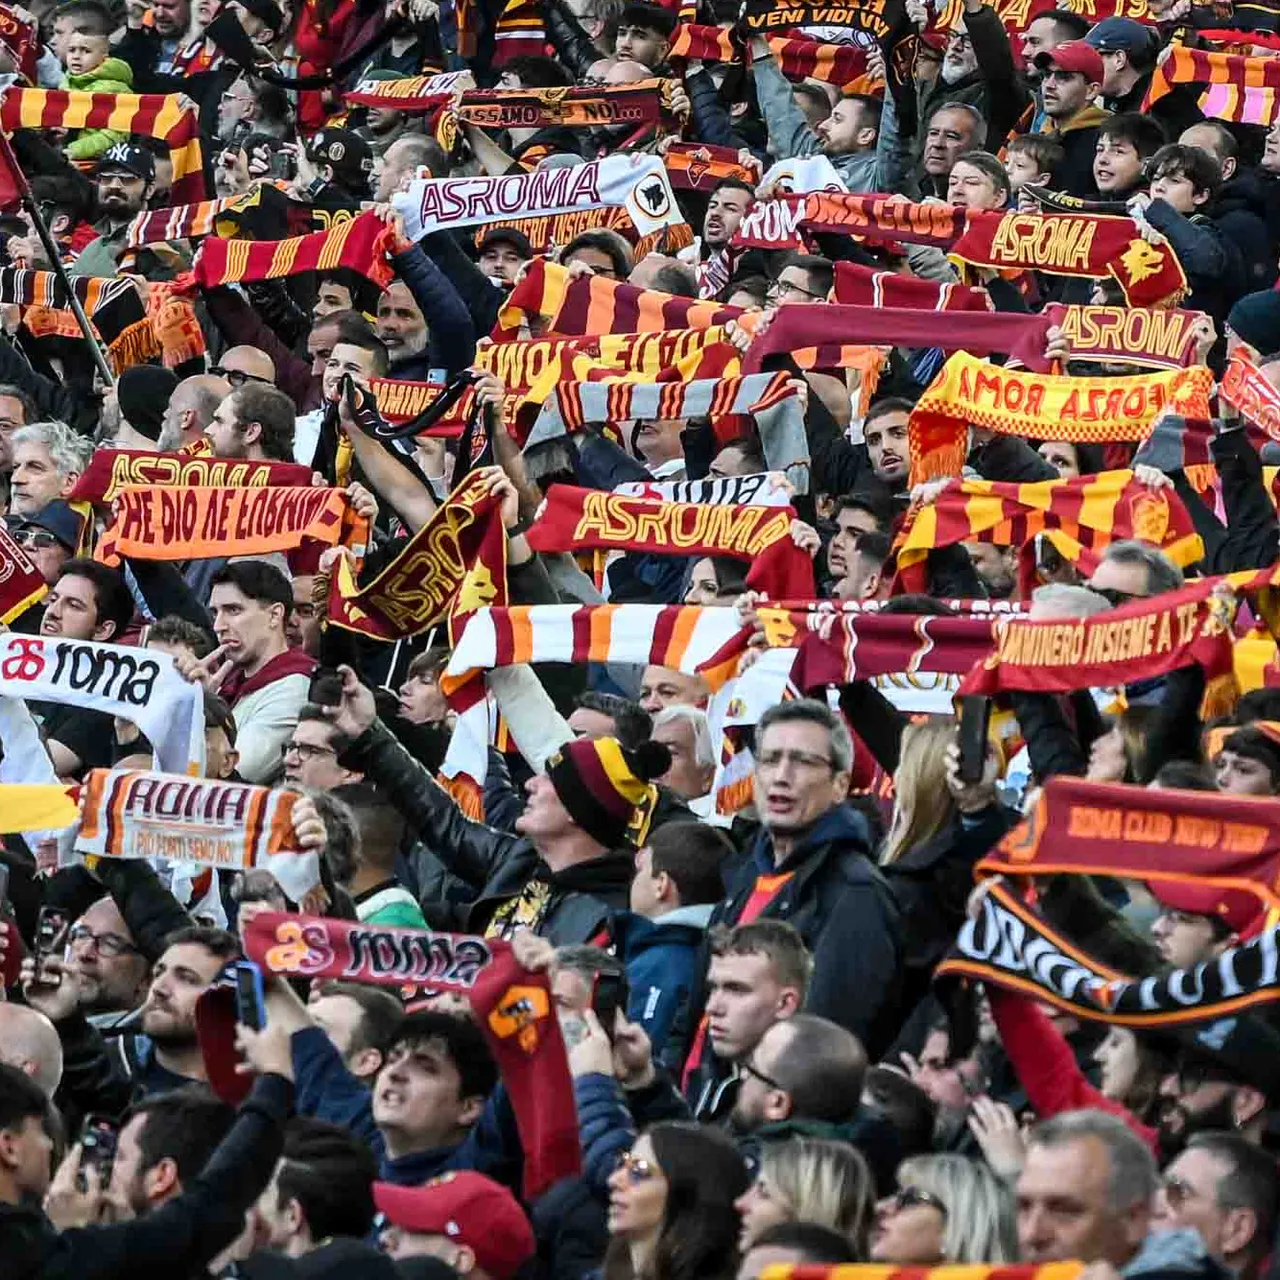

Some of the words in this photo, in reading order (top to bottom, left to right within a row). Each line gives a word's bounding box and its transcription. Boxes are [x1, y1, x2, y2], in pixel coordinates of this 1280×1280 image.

[0, 637, 47, 682] as
[51, 641, 162, 708] roma
[123, 779, 247, 822] ROMA
